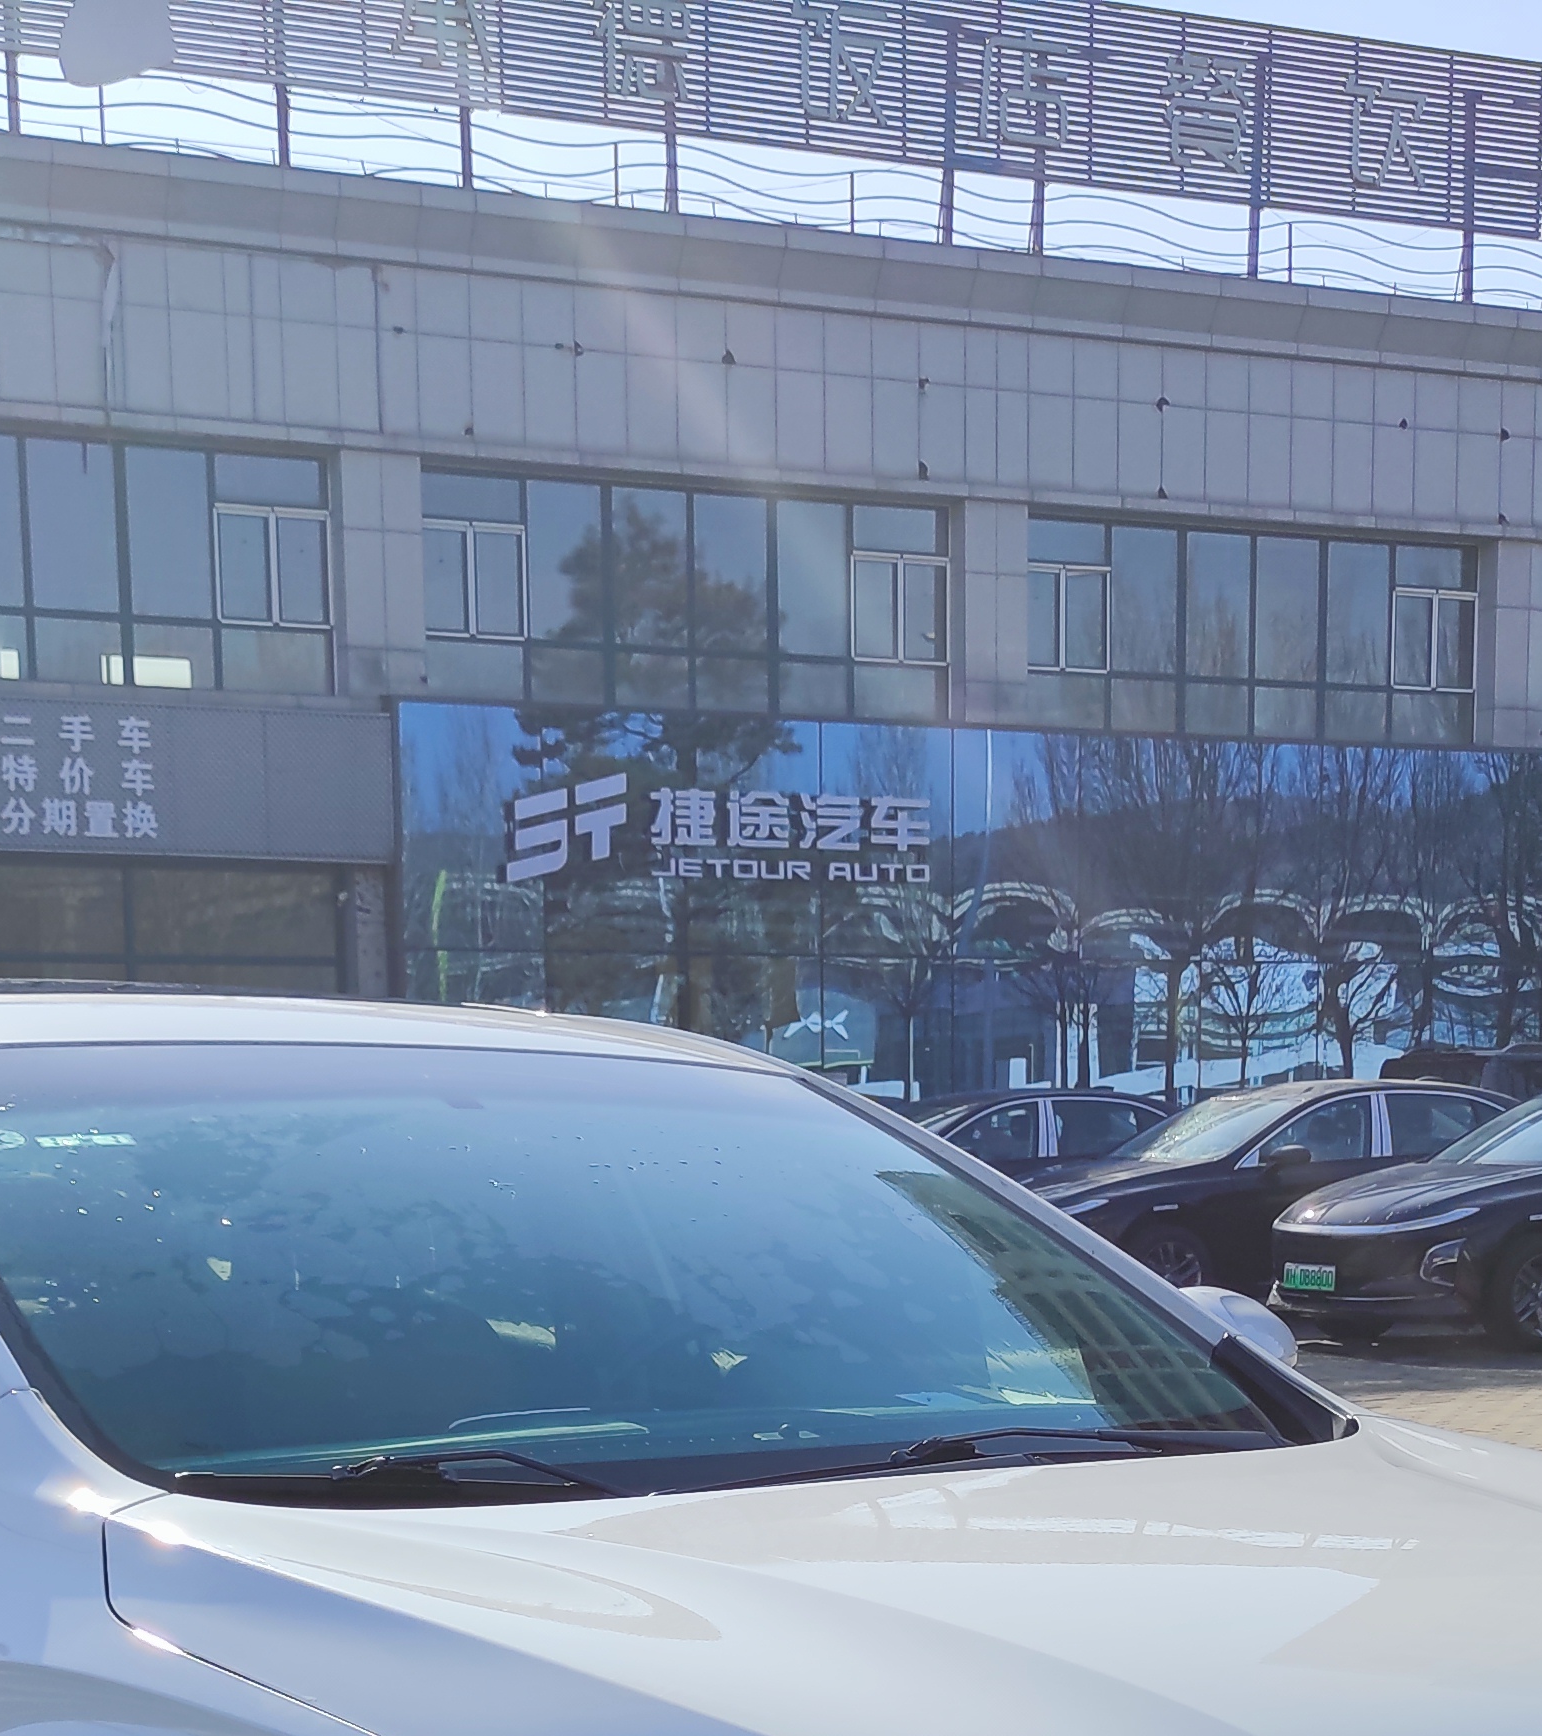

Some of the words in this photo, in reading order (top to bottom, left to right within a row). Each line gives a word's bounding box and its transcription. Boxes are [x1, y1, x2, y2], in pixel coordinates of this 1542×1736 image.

[0, 715, 152, 755] 二手车
[1, 753, 156, 797] 特价车
[0, 796, 159, 839] 分期置换
[650, 786, 931, 852] 捷途汽车
[651, 858, 811, 881] JETOUR
[828, 861, 931, 883] AUTO
